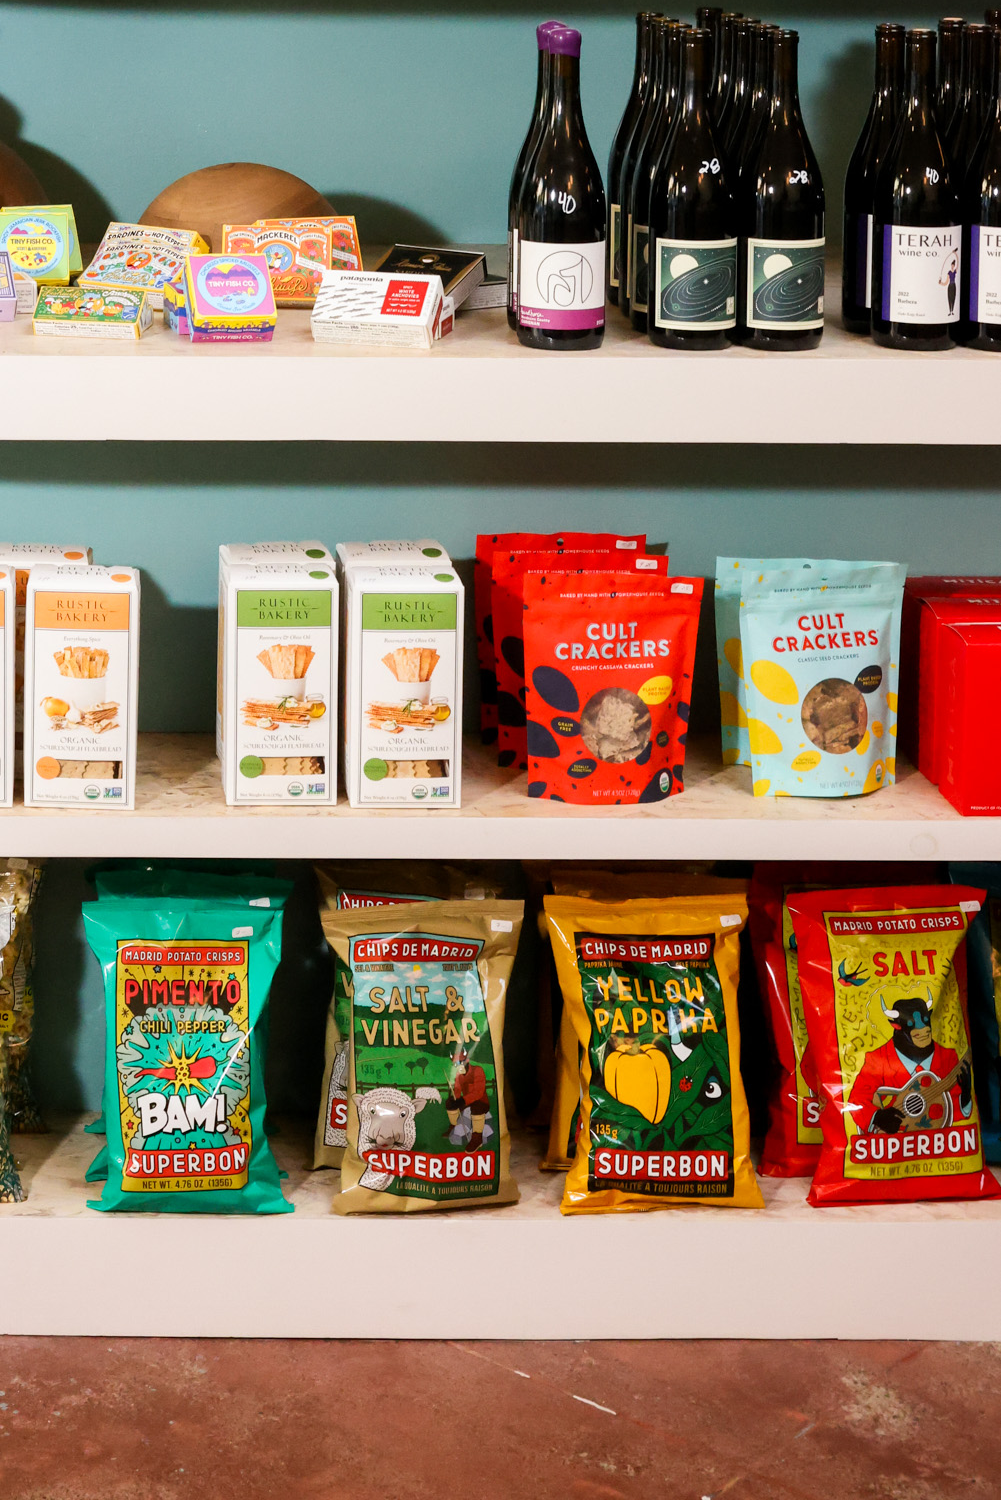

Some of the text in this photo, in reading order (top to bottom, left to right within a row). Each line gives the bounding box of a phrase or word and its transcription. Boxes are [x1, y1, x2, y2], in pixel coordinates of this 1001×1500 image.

[699, 158, 720, 175] 28
[789, 170, 808, 184] 28
[558, 191, 576, 214] 40
[256, 232, 298, 244] MACKEREL
[896, 233, 952, 247] TERAH
[105, 244, 143, 252] SARDINES
[57, 600, 107, 610] RUSTIC
[259, 598, 311, 607] RUSTIC
[385, 601, 436, 611] RUSTIC
[56, 612, 108, 622] BAKERY
[259, 610, 310, 619] BAKERY
[384, 613, 436, 623] BAKERY
[797, 613, 845, 632] CULT
[586, 622, 638, 640] CULT
[554, 639, 670, 660] CRACKERS
[772, 630, 879, 653] CRACKERS
[60, 736, 101, 744] ORGANIC
[834, 917, 960, 931] MADRID POTATO CRISPS
[125, 951, 241, 962] MADRID POTATO CRISPS
[357, 943, 474, 958] CHIPS DE MADRID
[585, 942, 708, 958] CHIPS DE MADRID
[873, 950, 937, 977] SALT
[125, 978, 241, 1006] PIMENTO
[597, 976, 704, 1004] YELLOW
[369, 986, 464, 1014] SALT &
[140, 1021, 227, 1034] CHILI PEPPER
[361, 1018, 480, 1046] VINEGAR
[138, 1092, 229, 1138] BAM!
[595, 1123, 618, 1140] 135g
[855, 1128, 976, 1159] SUPERBON
[129, 1148, 246, 1174] SUPERBON
[368, 1153, 492, 1179] SUPERBON
[598, 1153, 725, 1178] SUPERBON
[870, 1165, 886, 1176] NET
[904, 1164, 921, 1175] 4.76
[922, 1164, 934, 1173] OZ
[142, 1179, 233, 1190] NET WT. 4.76 OZ (135G)
